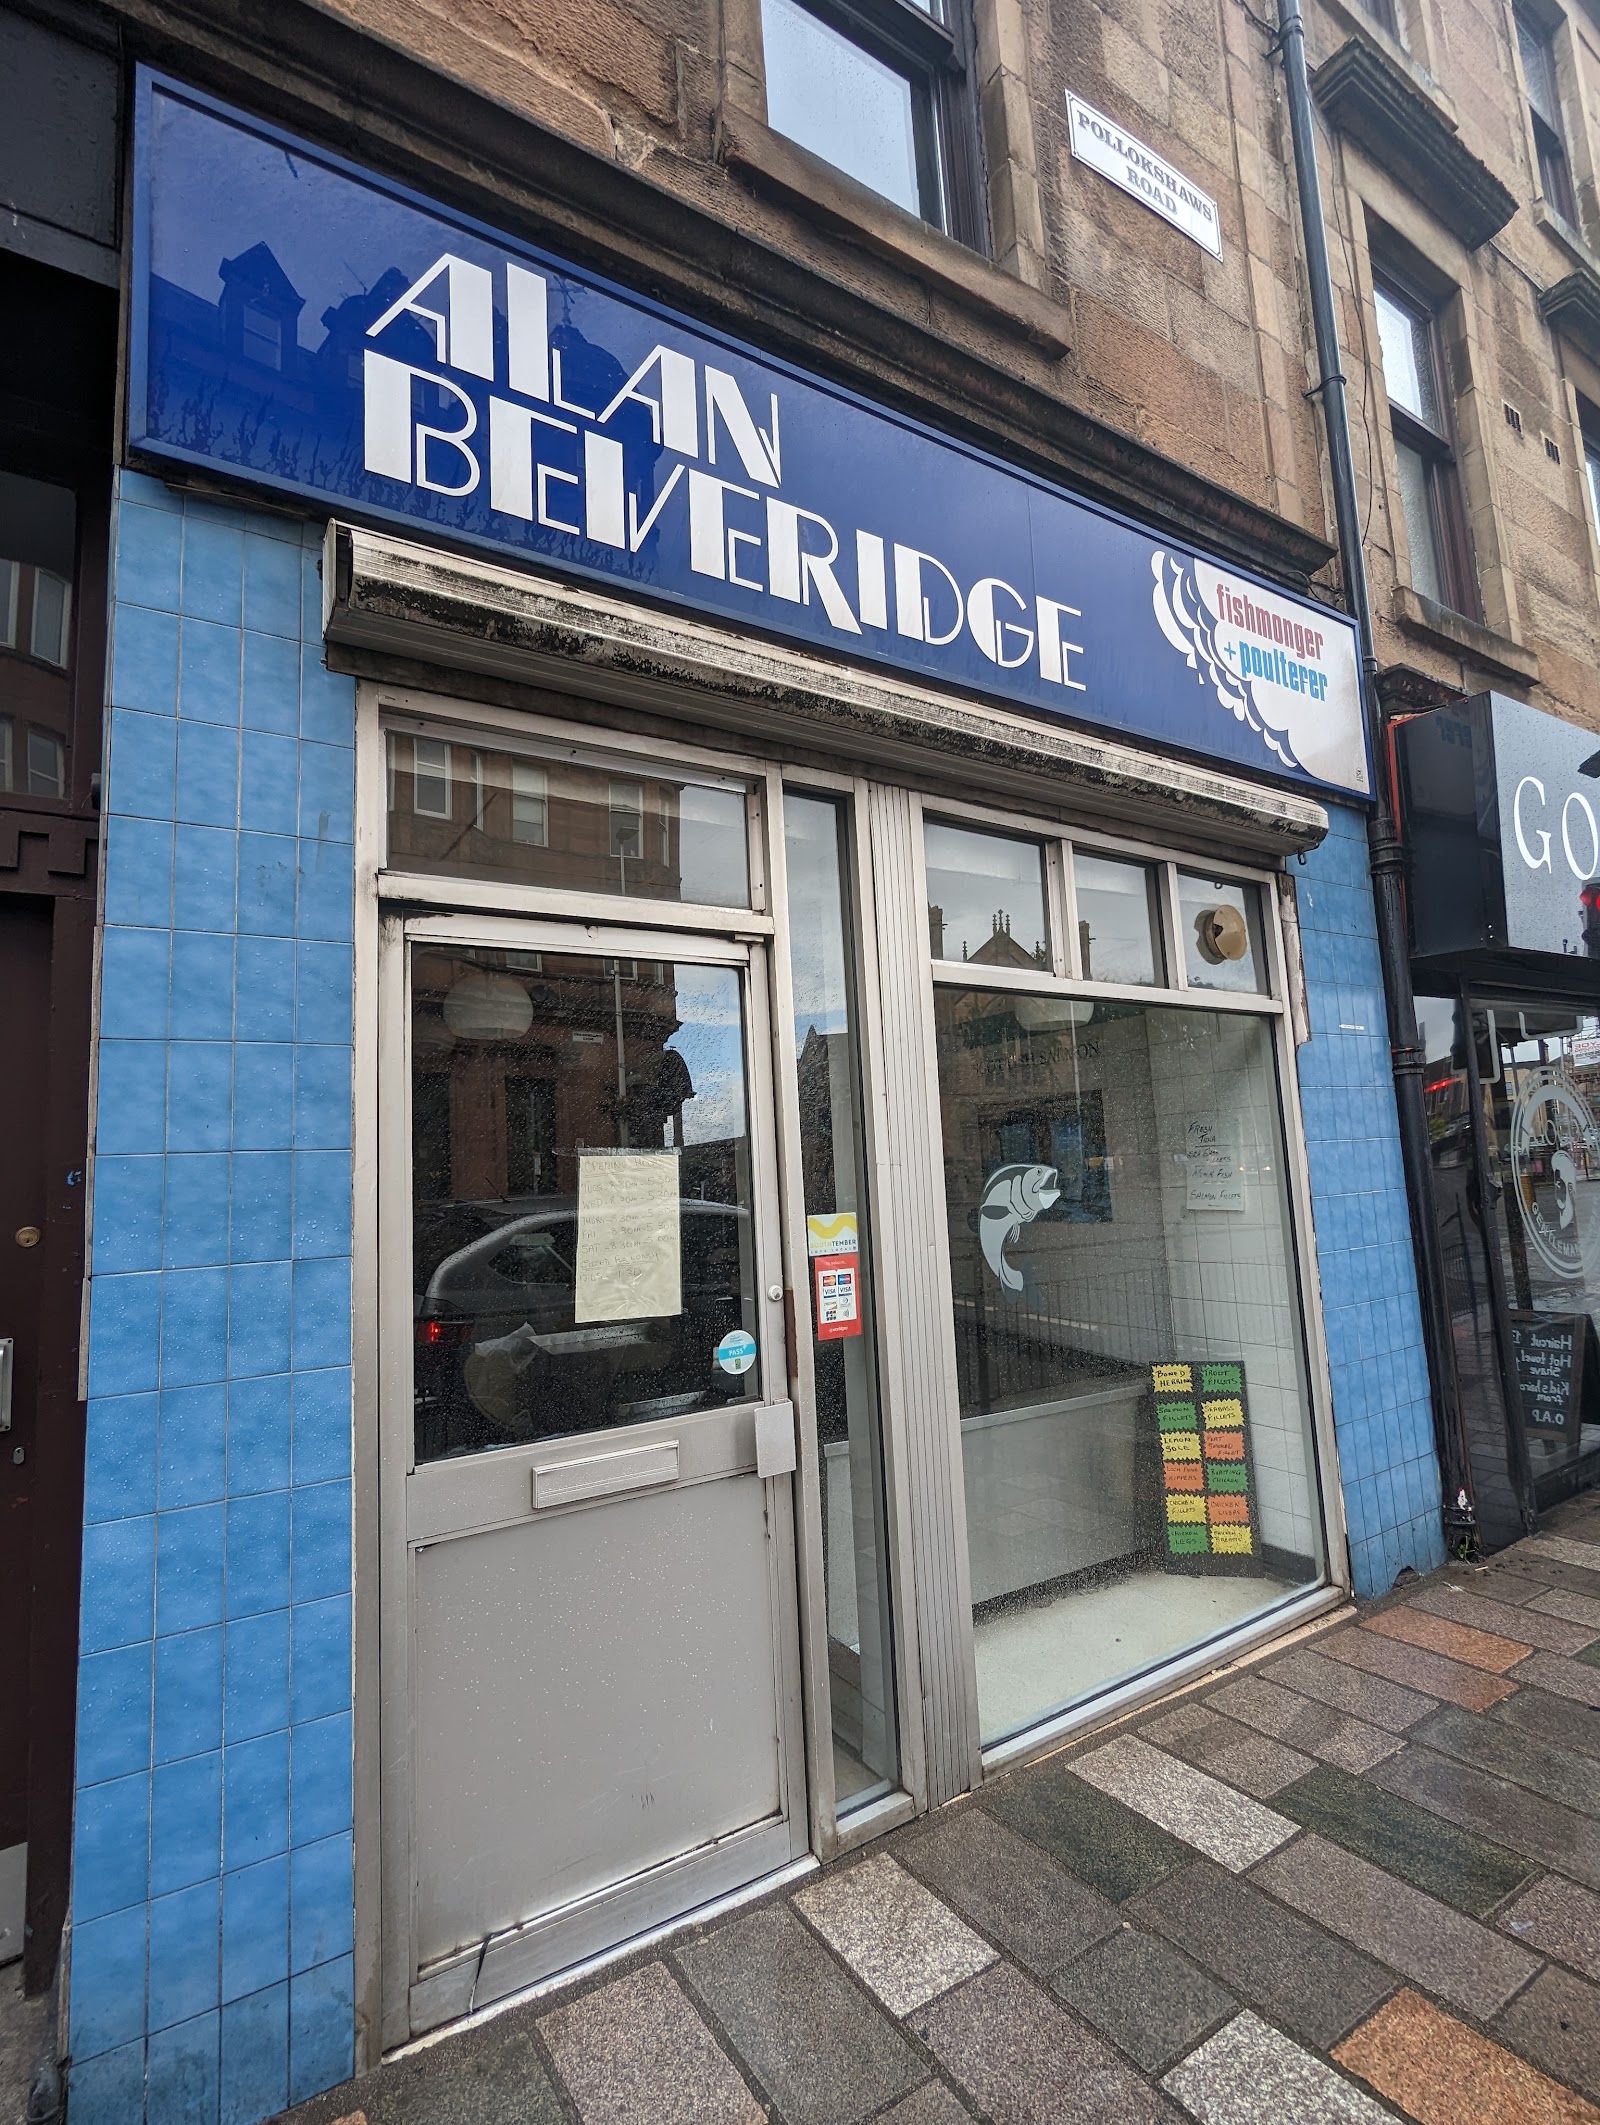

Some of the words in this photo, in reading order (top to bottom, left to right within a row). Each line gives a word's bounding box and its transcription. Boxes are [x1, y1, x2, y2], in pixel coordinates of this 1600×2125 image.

[1076, 109, 1213, 223] POLLOKSHAWS
[1125, 165, 1178, 215] ROAD
[365, 253, 781, 488] ALAN
[363, 348, 1087, 692] BEVERIDGE
[1216, 583, 1324, 660] fishmonger
[1238, 640, 1328, 701] poulterer
[585, 1160, 627, 1173] OPENING
[728, 1347, 744, 1357] PASS
[1203, 1369, 1230, 1377] TROUT
[1207, 1378, 1238, 1386] FILLETS
[1207, 1412, 1236, 1422] FILLETS
[1165, 1445, 1190, 1453] SOLE
